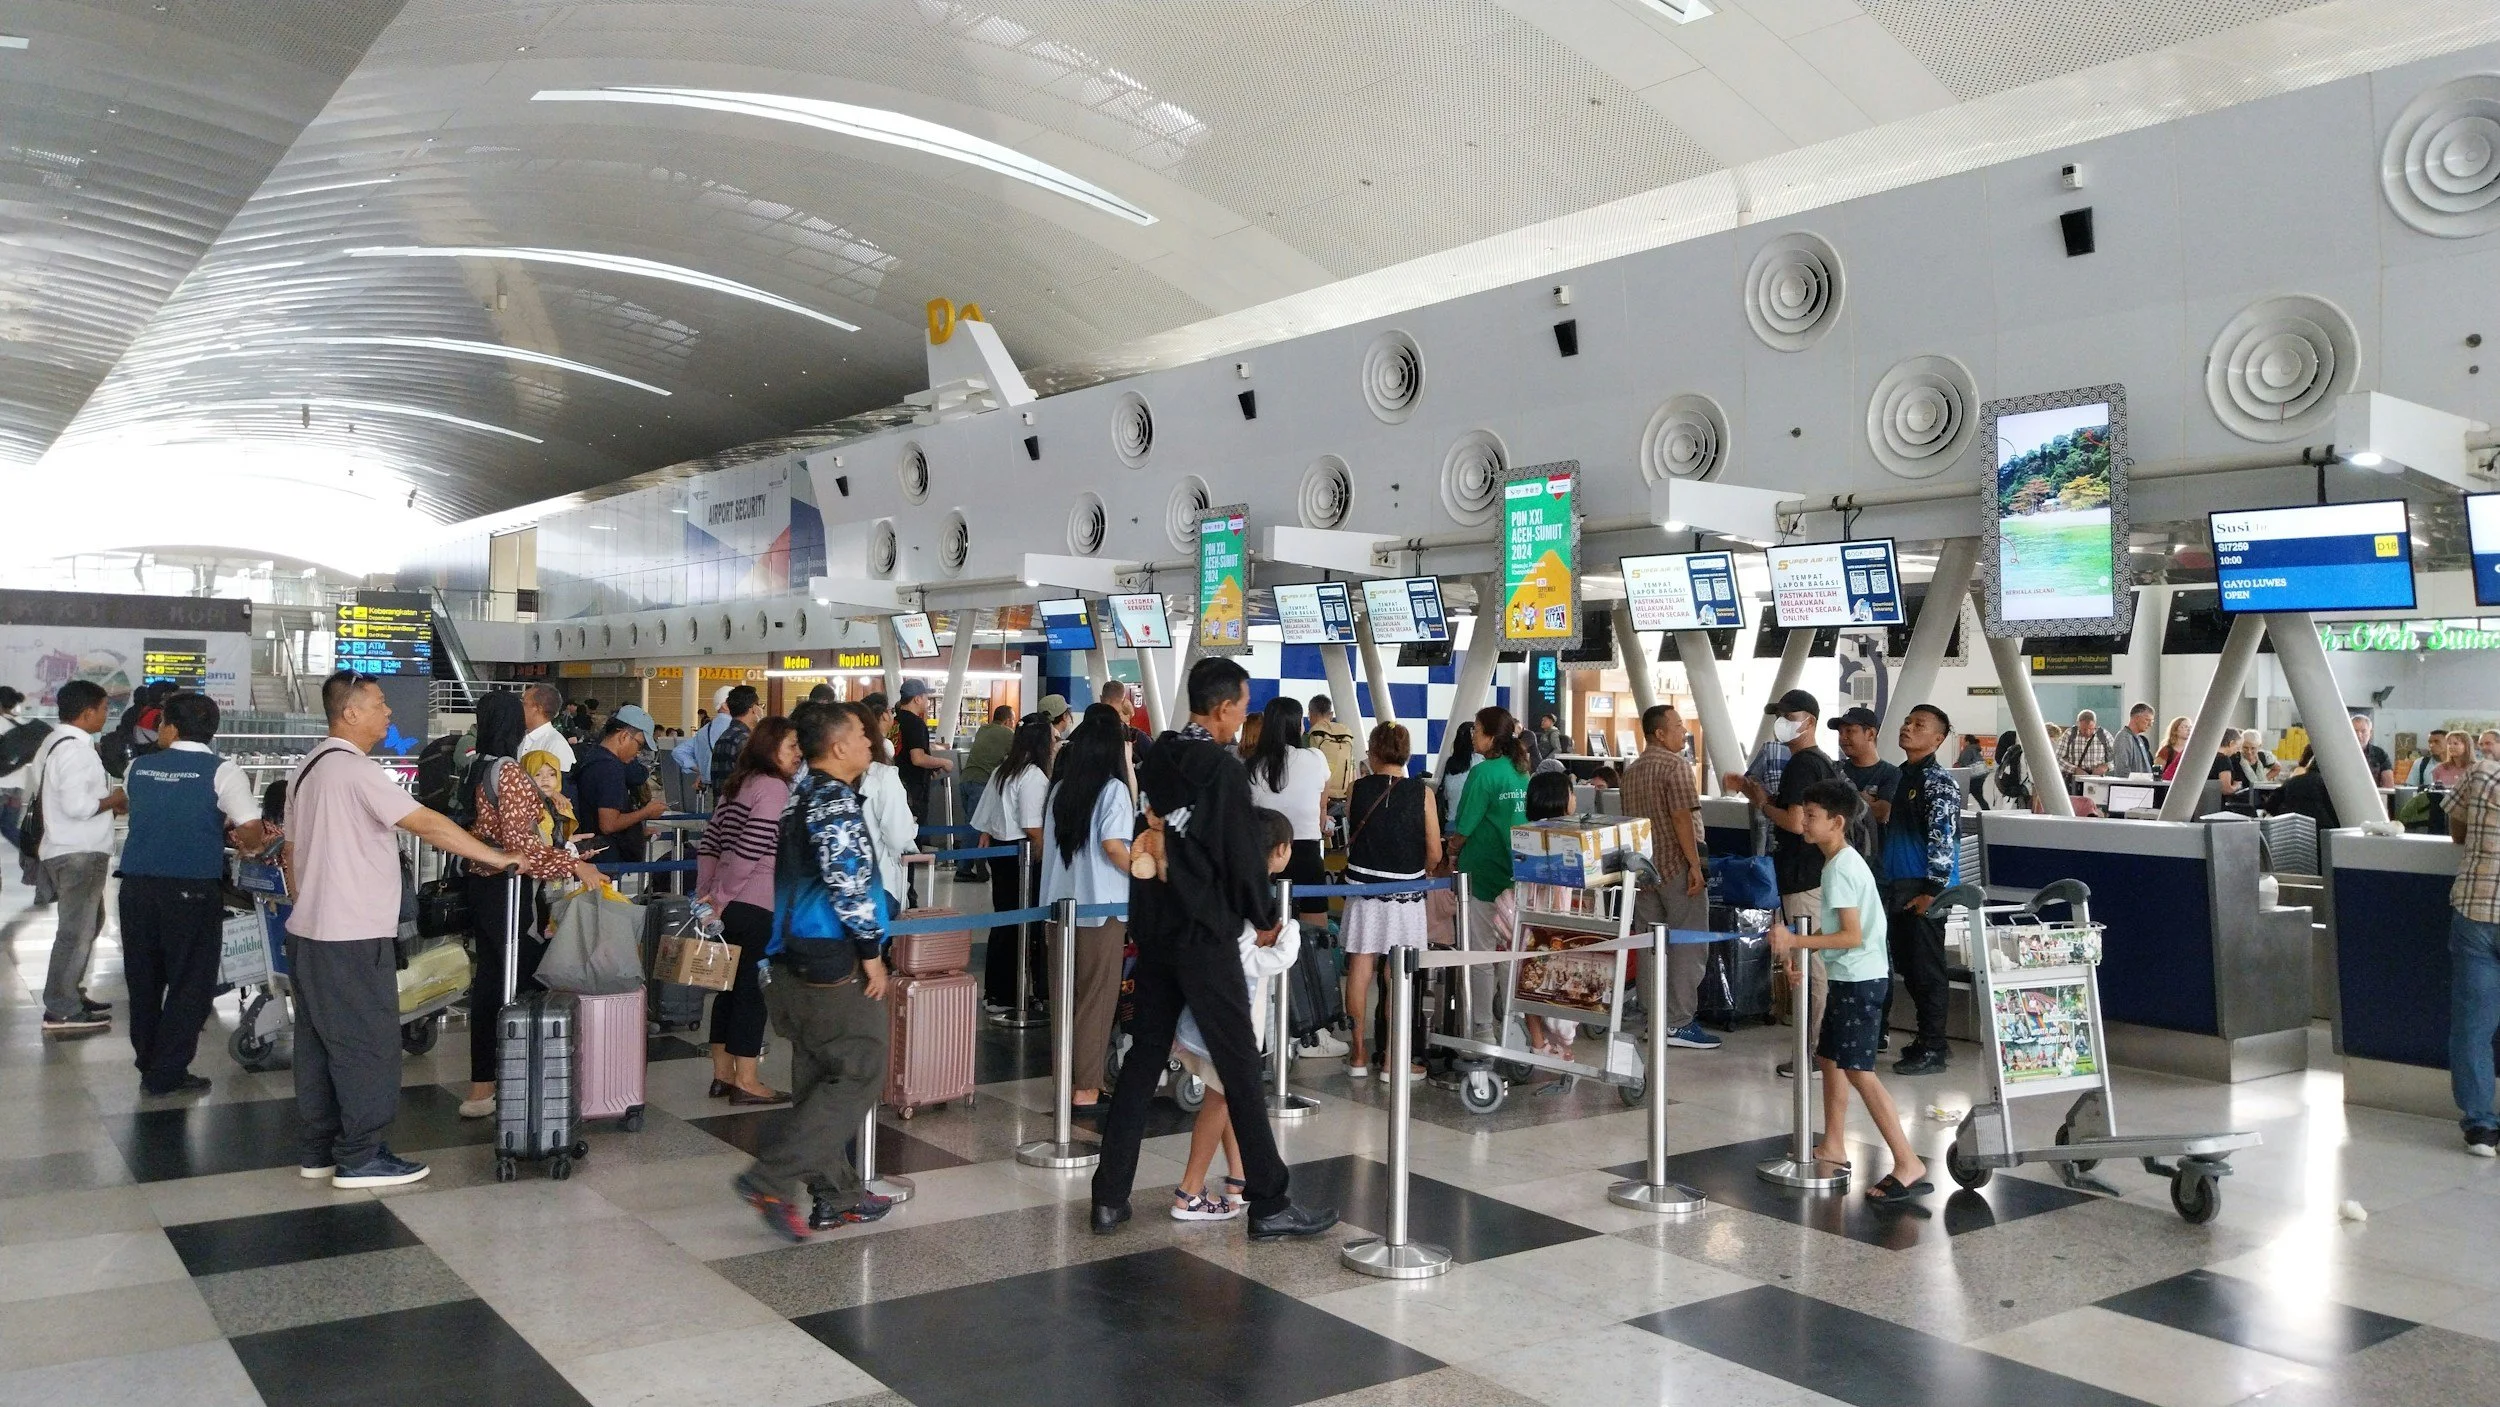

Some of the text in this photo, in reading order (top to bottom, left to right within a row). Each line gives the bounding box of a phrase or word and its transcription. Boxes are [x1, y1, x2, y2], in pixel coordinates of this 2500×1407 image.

[709, 494, 766, 526] AIRPORT SECURITY
[1511, 508, 1543, 527] PON XXI
[1511, 523, 1563, 543] ACEH-SUMUT
[2216, 520, 2250, 534] Susi
[1511, 543, 1532, 560] 2024
[2217, 542, 2249, 552] SI7259
[2377, 541, 2397, 551] D18
[1205, 554, 1238, 570] ACEH-SUMUT
[1778, 557, 1808, 570] SUPER
[2219, 556, 2243, 565] 10:00
[1205, 570, 1219, 583] 2024
[1790, 573, 1823, 581] TEMPAT
[1778, 581, 1806, 589] LAPOR
[2223, 578, 2287, 589] GAYO LUWES
[1632, 588, 1655, 596] LAPOR
[2224, 590, 2250, 600] OPEN
[368, 607, 418, 617] Keberangkatan
[2318, 622, 2420, 651] h-Oleh
[368, 642, 386, 650] ATM
[383, 660, 401, 669] Toilet
[783, 656, 810, 669] Medan
[656, 667, 746, 681] KHDIJAH
[135, 769, 168, 778] CONCIERGE
[223, 936, 263, 957] Zulaikha
